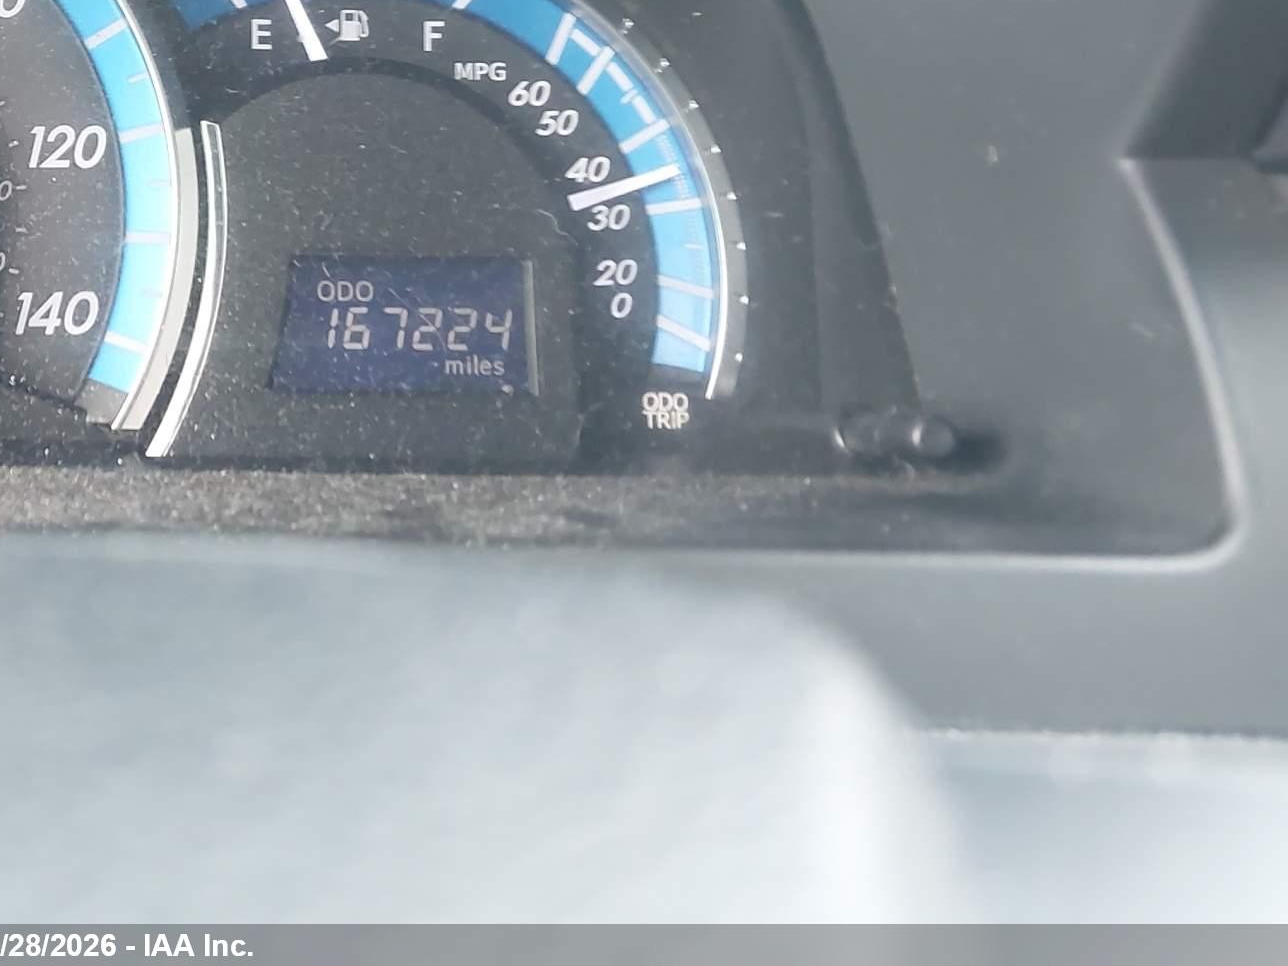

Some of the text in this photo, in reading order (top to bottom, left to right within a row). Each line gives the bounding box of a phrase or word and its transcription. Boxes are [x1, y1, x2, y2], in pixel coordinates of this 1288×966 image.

[251, 19, 272, 49] E
[423, 20, 445, 51] F
[454, 62, 507, 81] MPG
[509, 81, 551, 106] 60
[535, 110, 578, 136] 50
[29, 125, 107, 168] 120
[565, 156, 610, 182] 40
[588, 205, 630, 231] 30
[594, 260, 638, 286] 20
[317, 281, 374, 302] ODO
[16, 291, 99, 335] 140
[611, 293, 632, 318] 0
[326, 307, 512, 350] 167224
[445, 357, 505, 375] miles
[642, 392, 689, 411] ODO
[642, 412, 690, 429] TRIP
